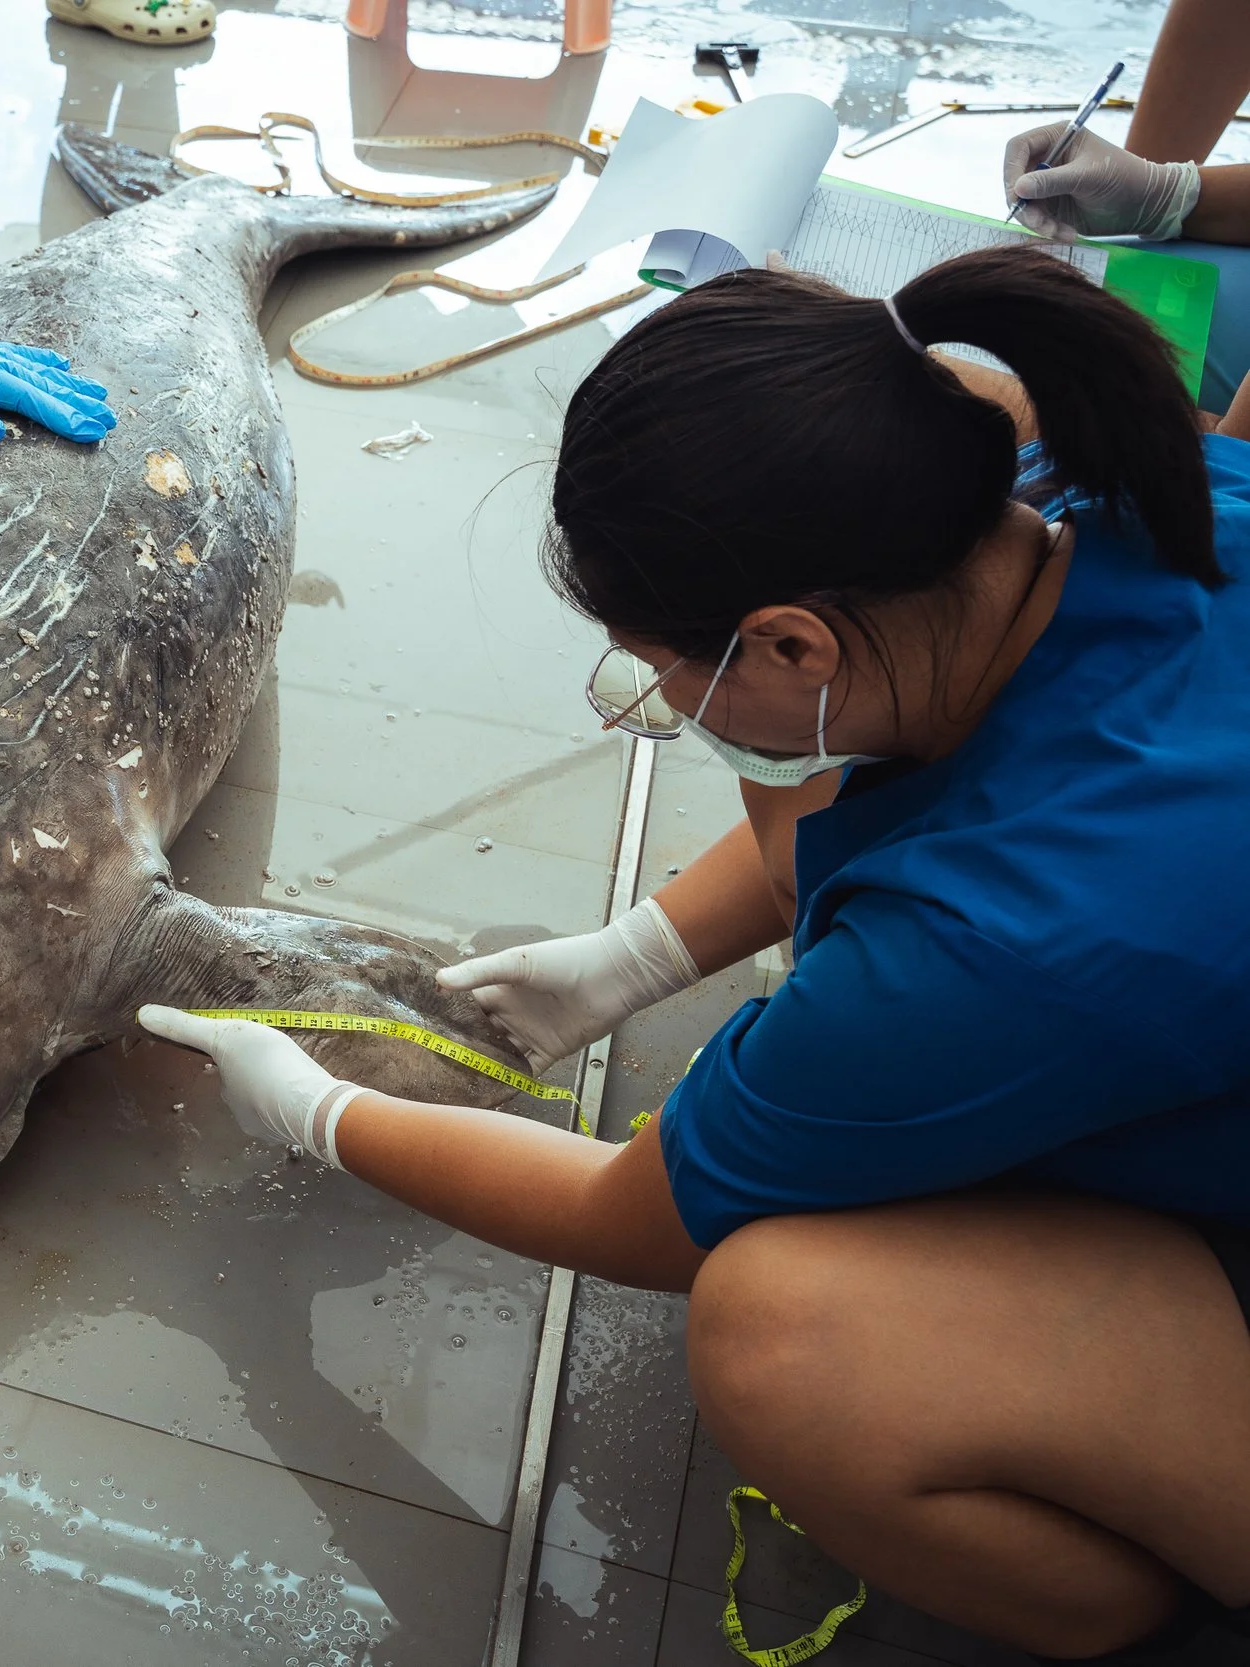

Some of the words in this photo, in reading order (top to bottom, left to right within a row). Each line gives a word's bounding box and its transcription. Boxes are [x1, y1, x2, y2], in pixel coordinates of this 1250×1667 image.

[310, 1019, 317, 1027] 12
[326, 1020, 333, 1028] 13
[341, 1020, 348, 1029] 14
[371, 1023, 377, 1031] 16
[382, 1026, 389, 1034] 17
[409, 1033, 417, 1041] 20
[435, 1043, 443, 1052] 22
[449, 1049, 457, 1058] 23
[462, 1055, 470, 1064] 24
[472, 1061, 481, 1069] 25
[494, 1070, 502, 1078] 27
